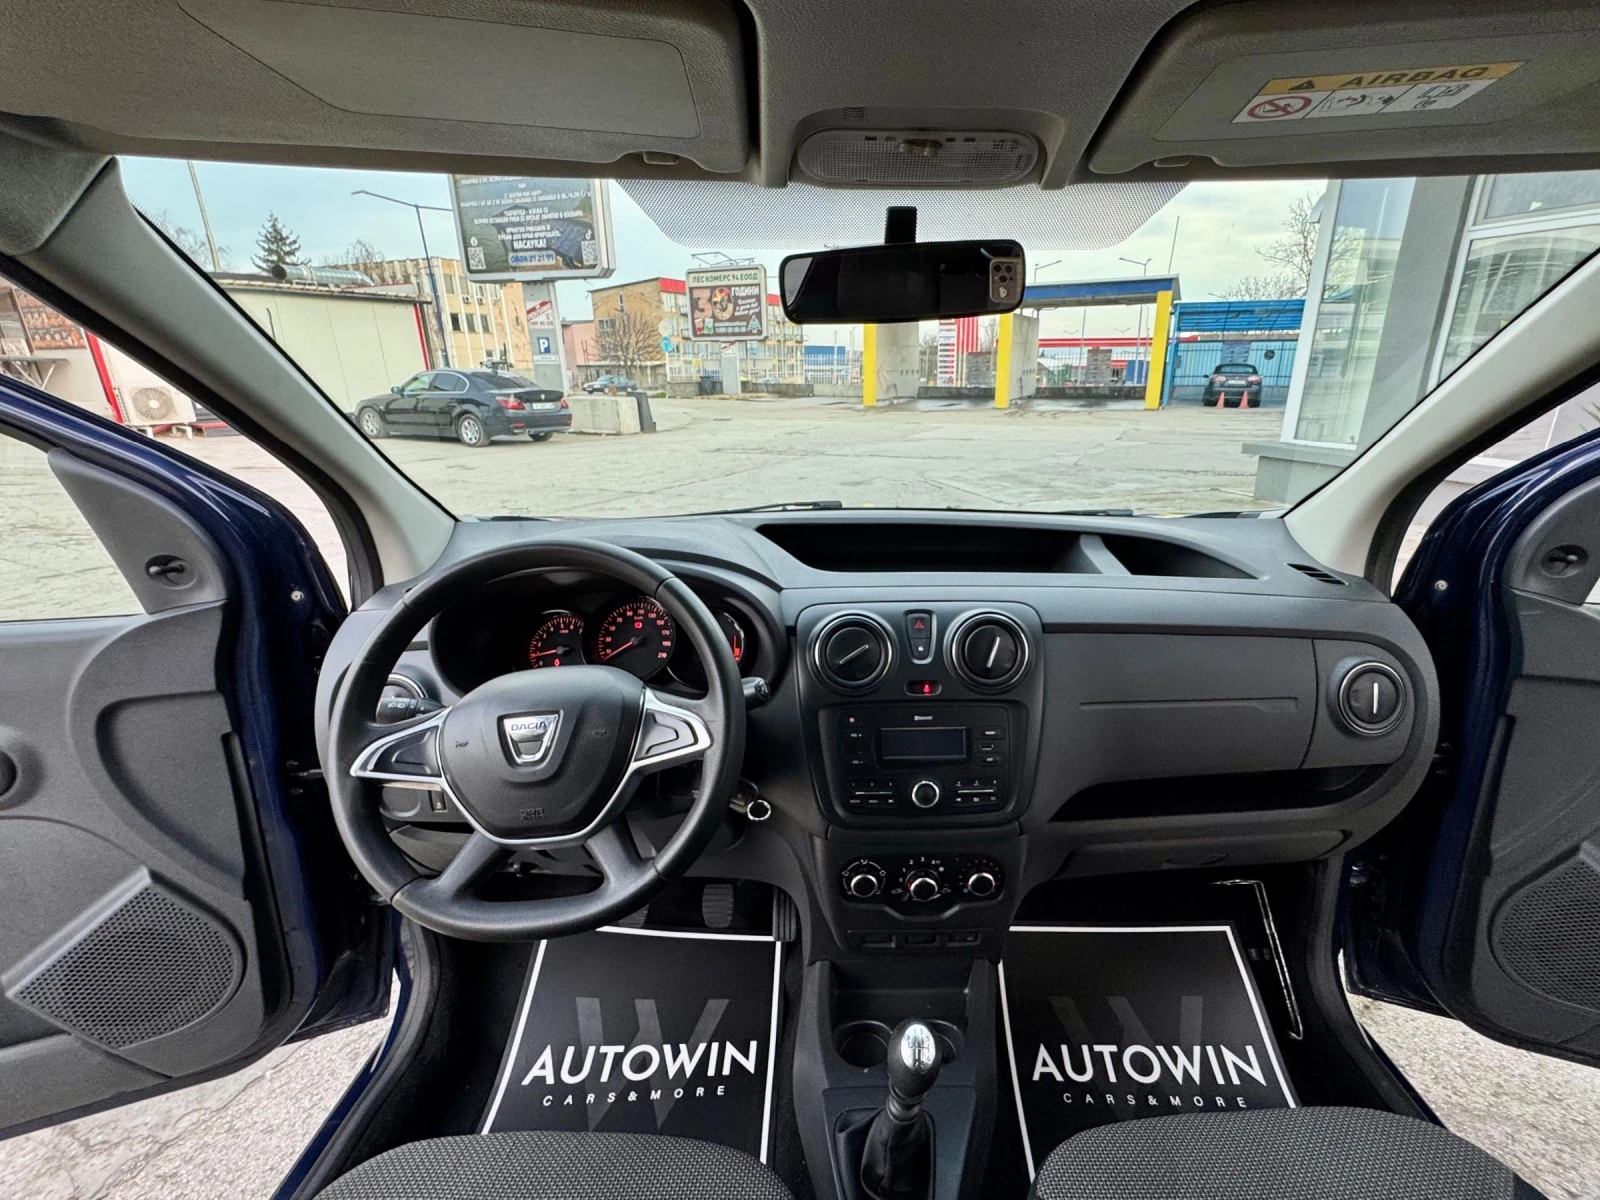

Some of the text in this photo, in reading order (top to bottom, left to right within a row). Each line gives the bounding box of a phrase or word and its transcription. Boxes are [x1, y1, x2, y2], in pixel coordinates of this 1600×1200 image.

[1341, 66, 1490, 87] AIRBAG
[705, 274, 731, 282] КОМЕРС
[740, 272, 758, 280] ЕООД
[731, 285, 759, 297] ГОДИНИ
[539, 338, 549, 353] P
[511, 721, 546, 731] DACIA
[521, 1040, 758, 1086] AUTOWIN
[1032, 1043, 1267, 1087] AUTOWIN
